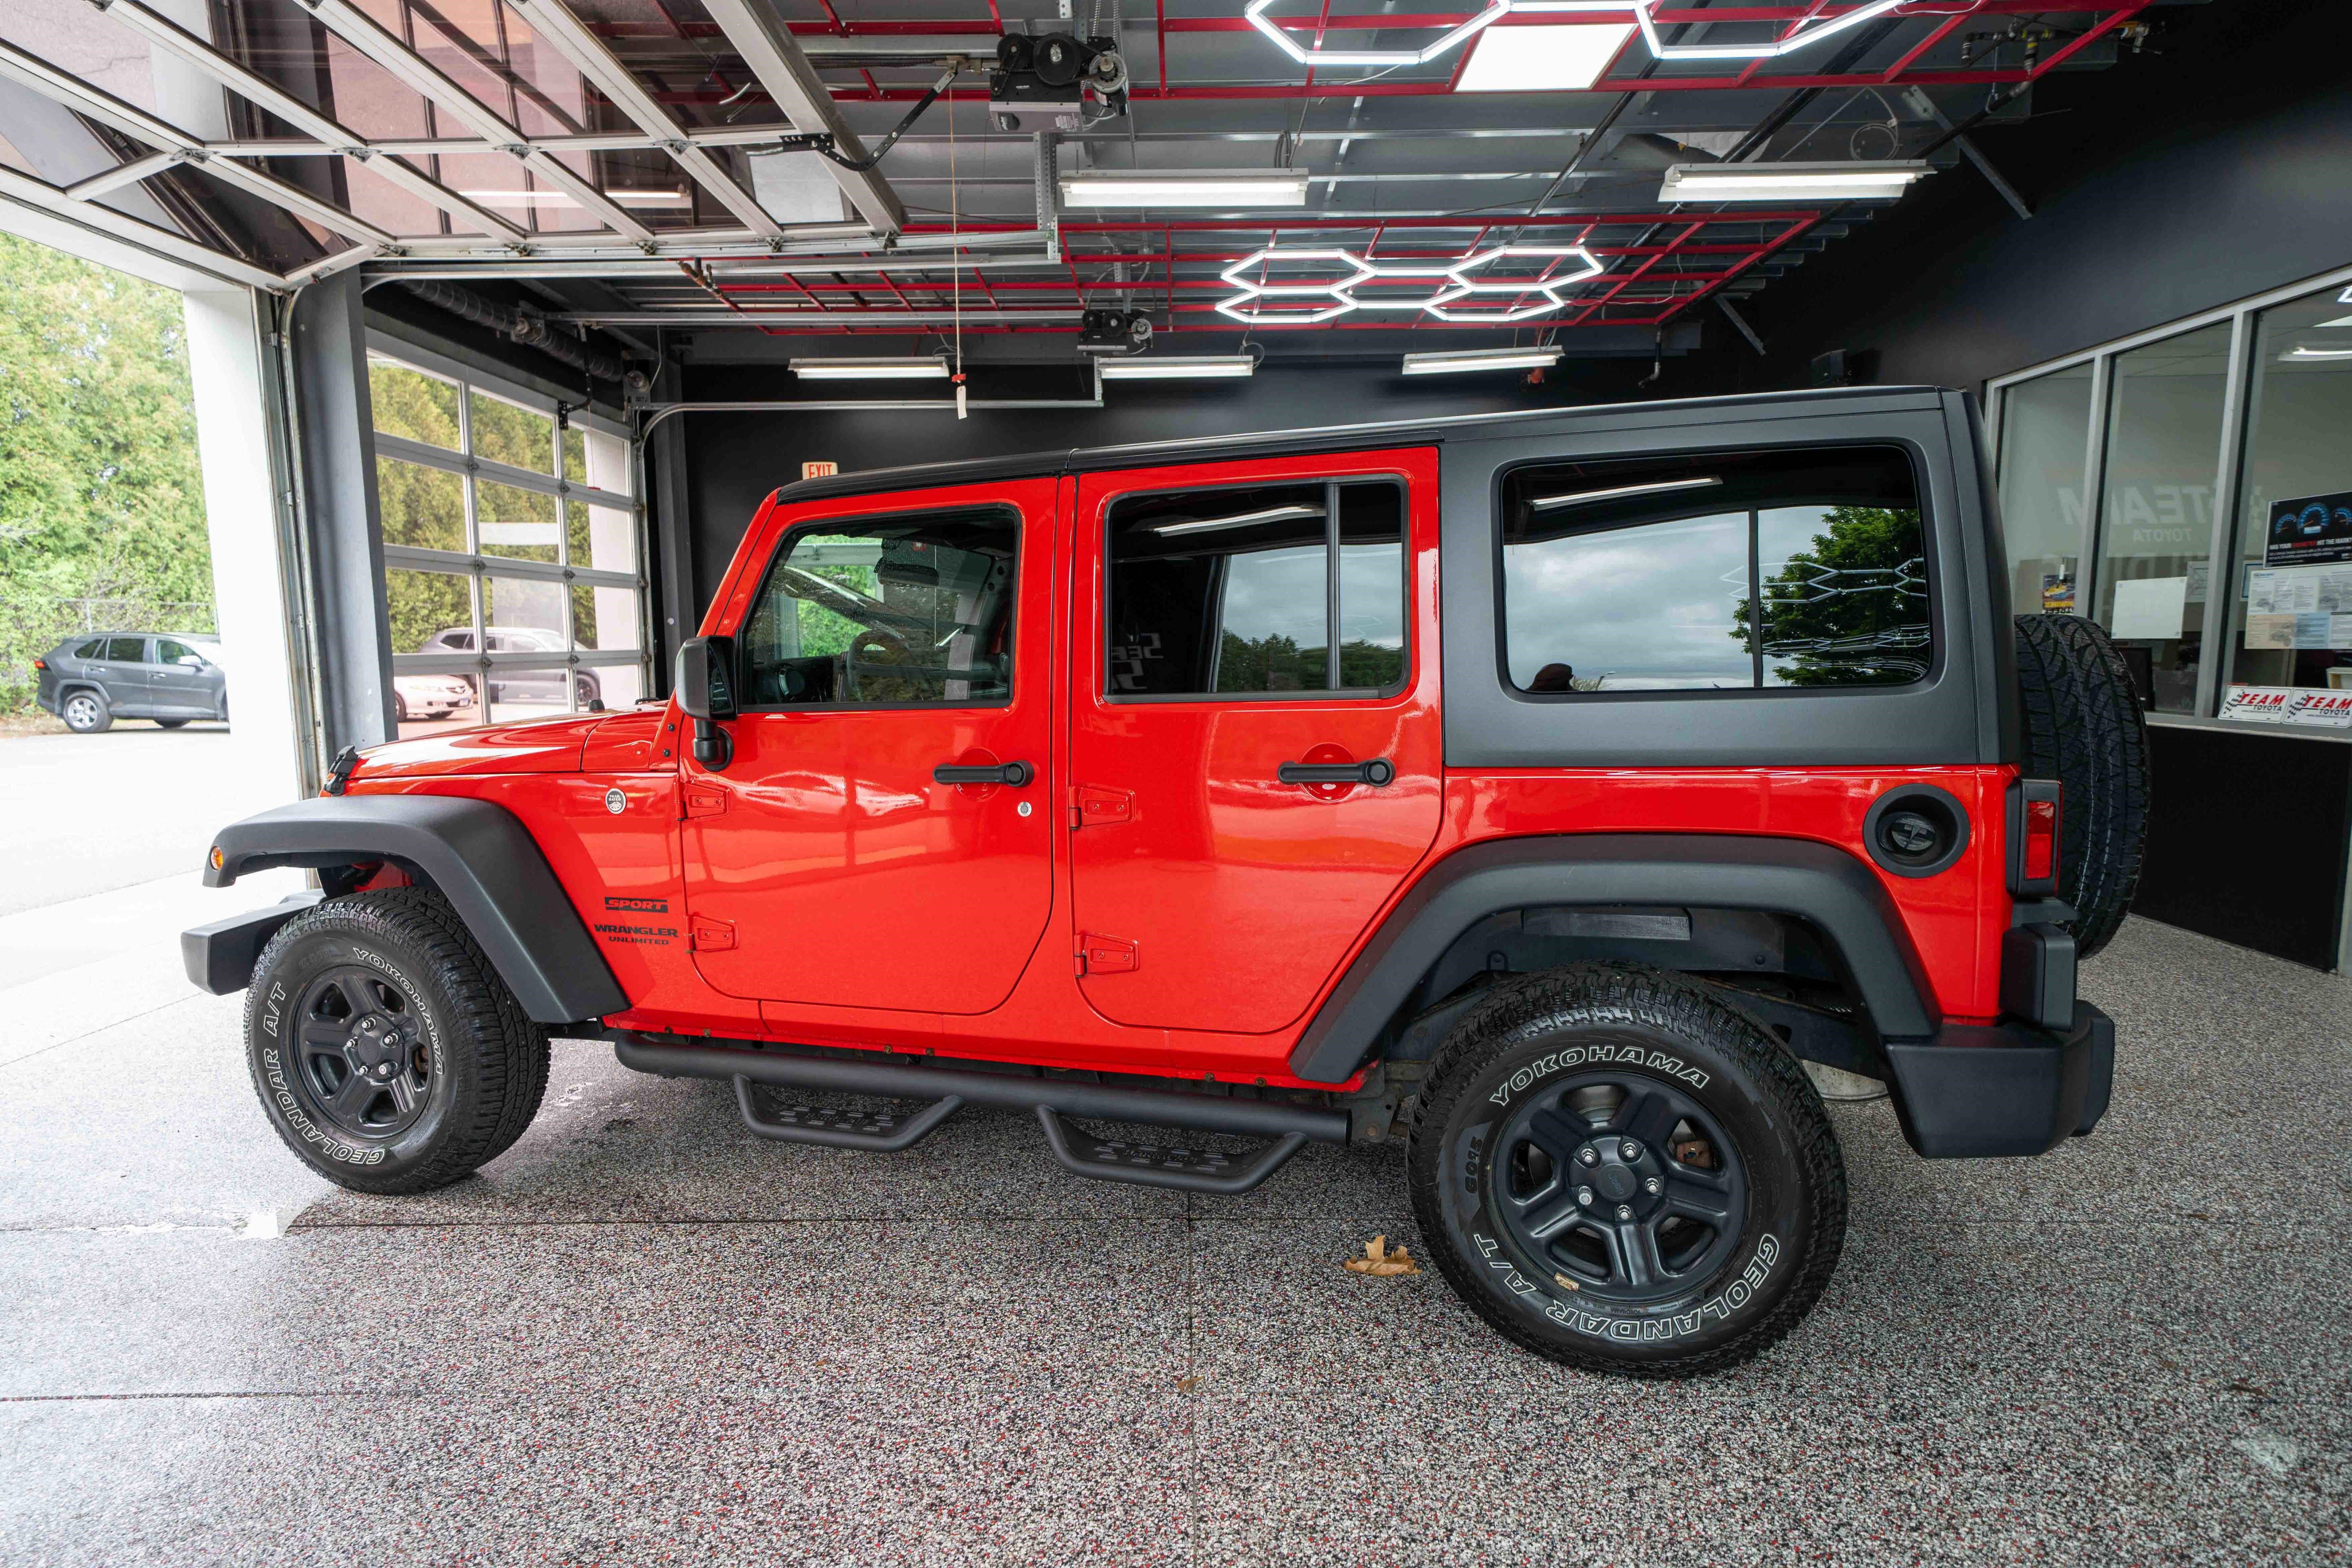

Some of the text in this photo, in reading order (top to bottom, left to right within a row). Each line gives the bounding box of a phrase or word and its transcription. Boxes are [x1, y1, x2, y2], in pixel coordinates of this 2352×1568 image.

[808, 464, 832, 479] EXIT
[2238, 693, 2286, 705] TEAM
[2303, 696, 2352, 708] TEAM
[606, 899, 667, 910] SPORT
[594, 924, 679, 938] WRANGLER
[608, 936, 669, 945] UNLIMITED
[263, 982, 290, 1038] A/T
[353, 947, 444, 1075] YOKOHAMA
[1490, 1045, 1710, 1107] YOKOHAMA
[264, 1048, 386, 1165] GEOLANDAR
[1473, 1232, 1780, 1341] GEOLANDAR A/T
